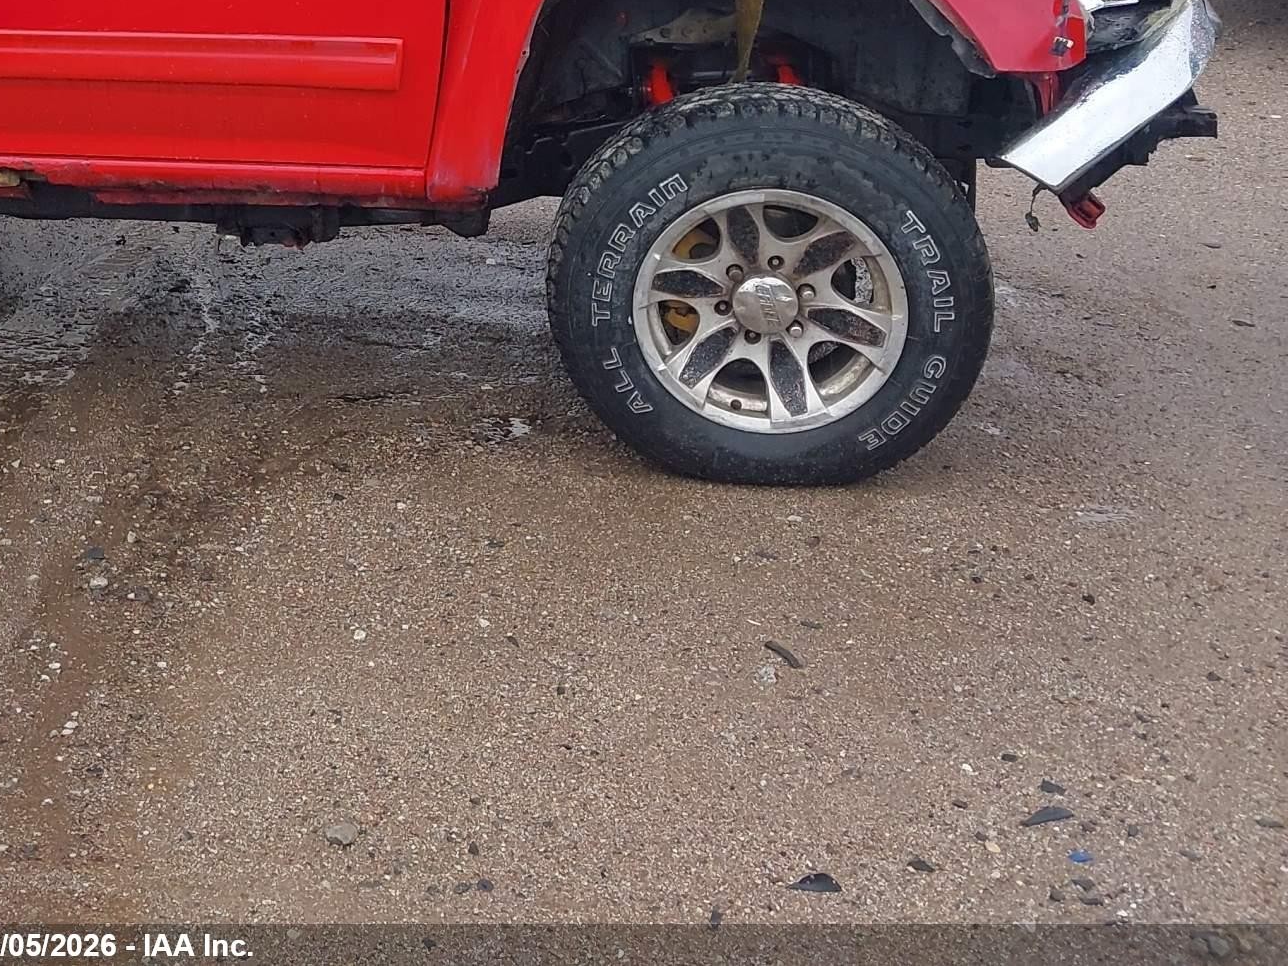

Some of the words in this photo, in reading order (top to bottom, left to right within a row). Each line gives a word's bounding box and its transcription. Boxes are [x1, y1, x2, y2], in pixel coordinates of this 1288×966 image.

[592, 173, 689, 327] TERRAIN
[900, 210, 955, 333] TRAIL
[603, 347, 654, 414] ALL
[858, 355, 947, 451] GUIDE
